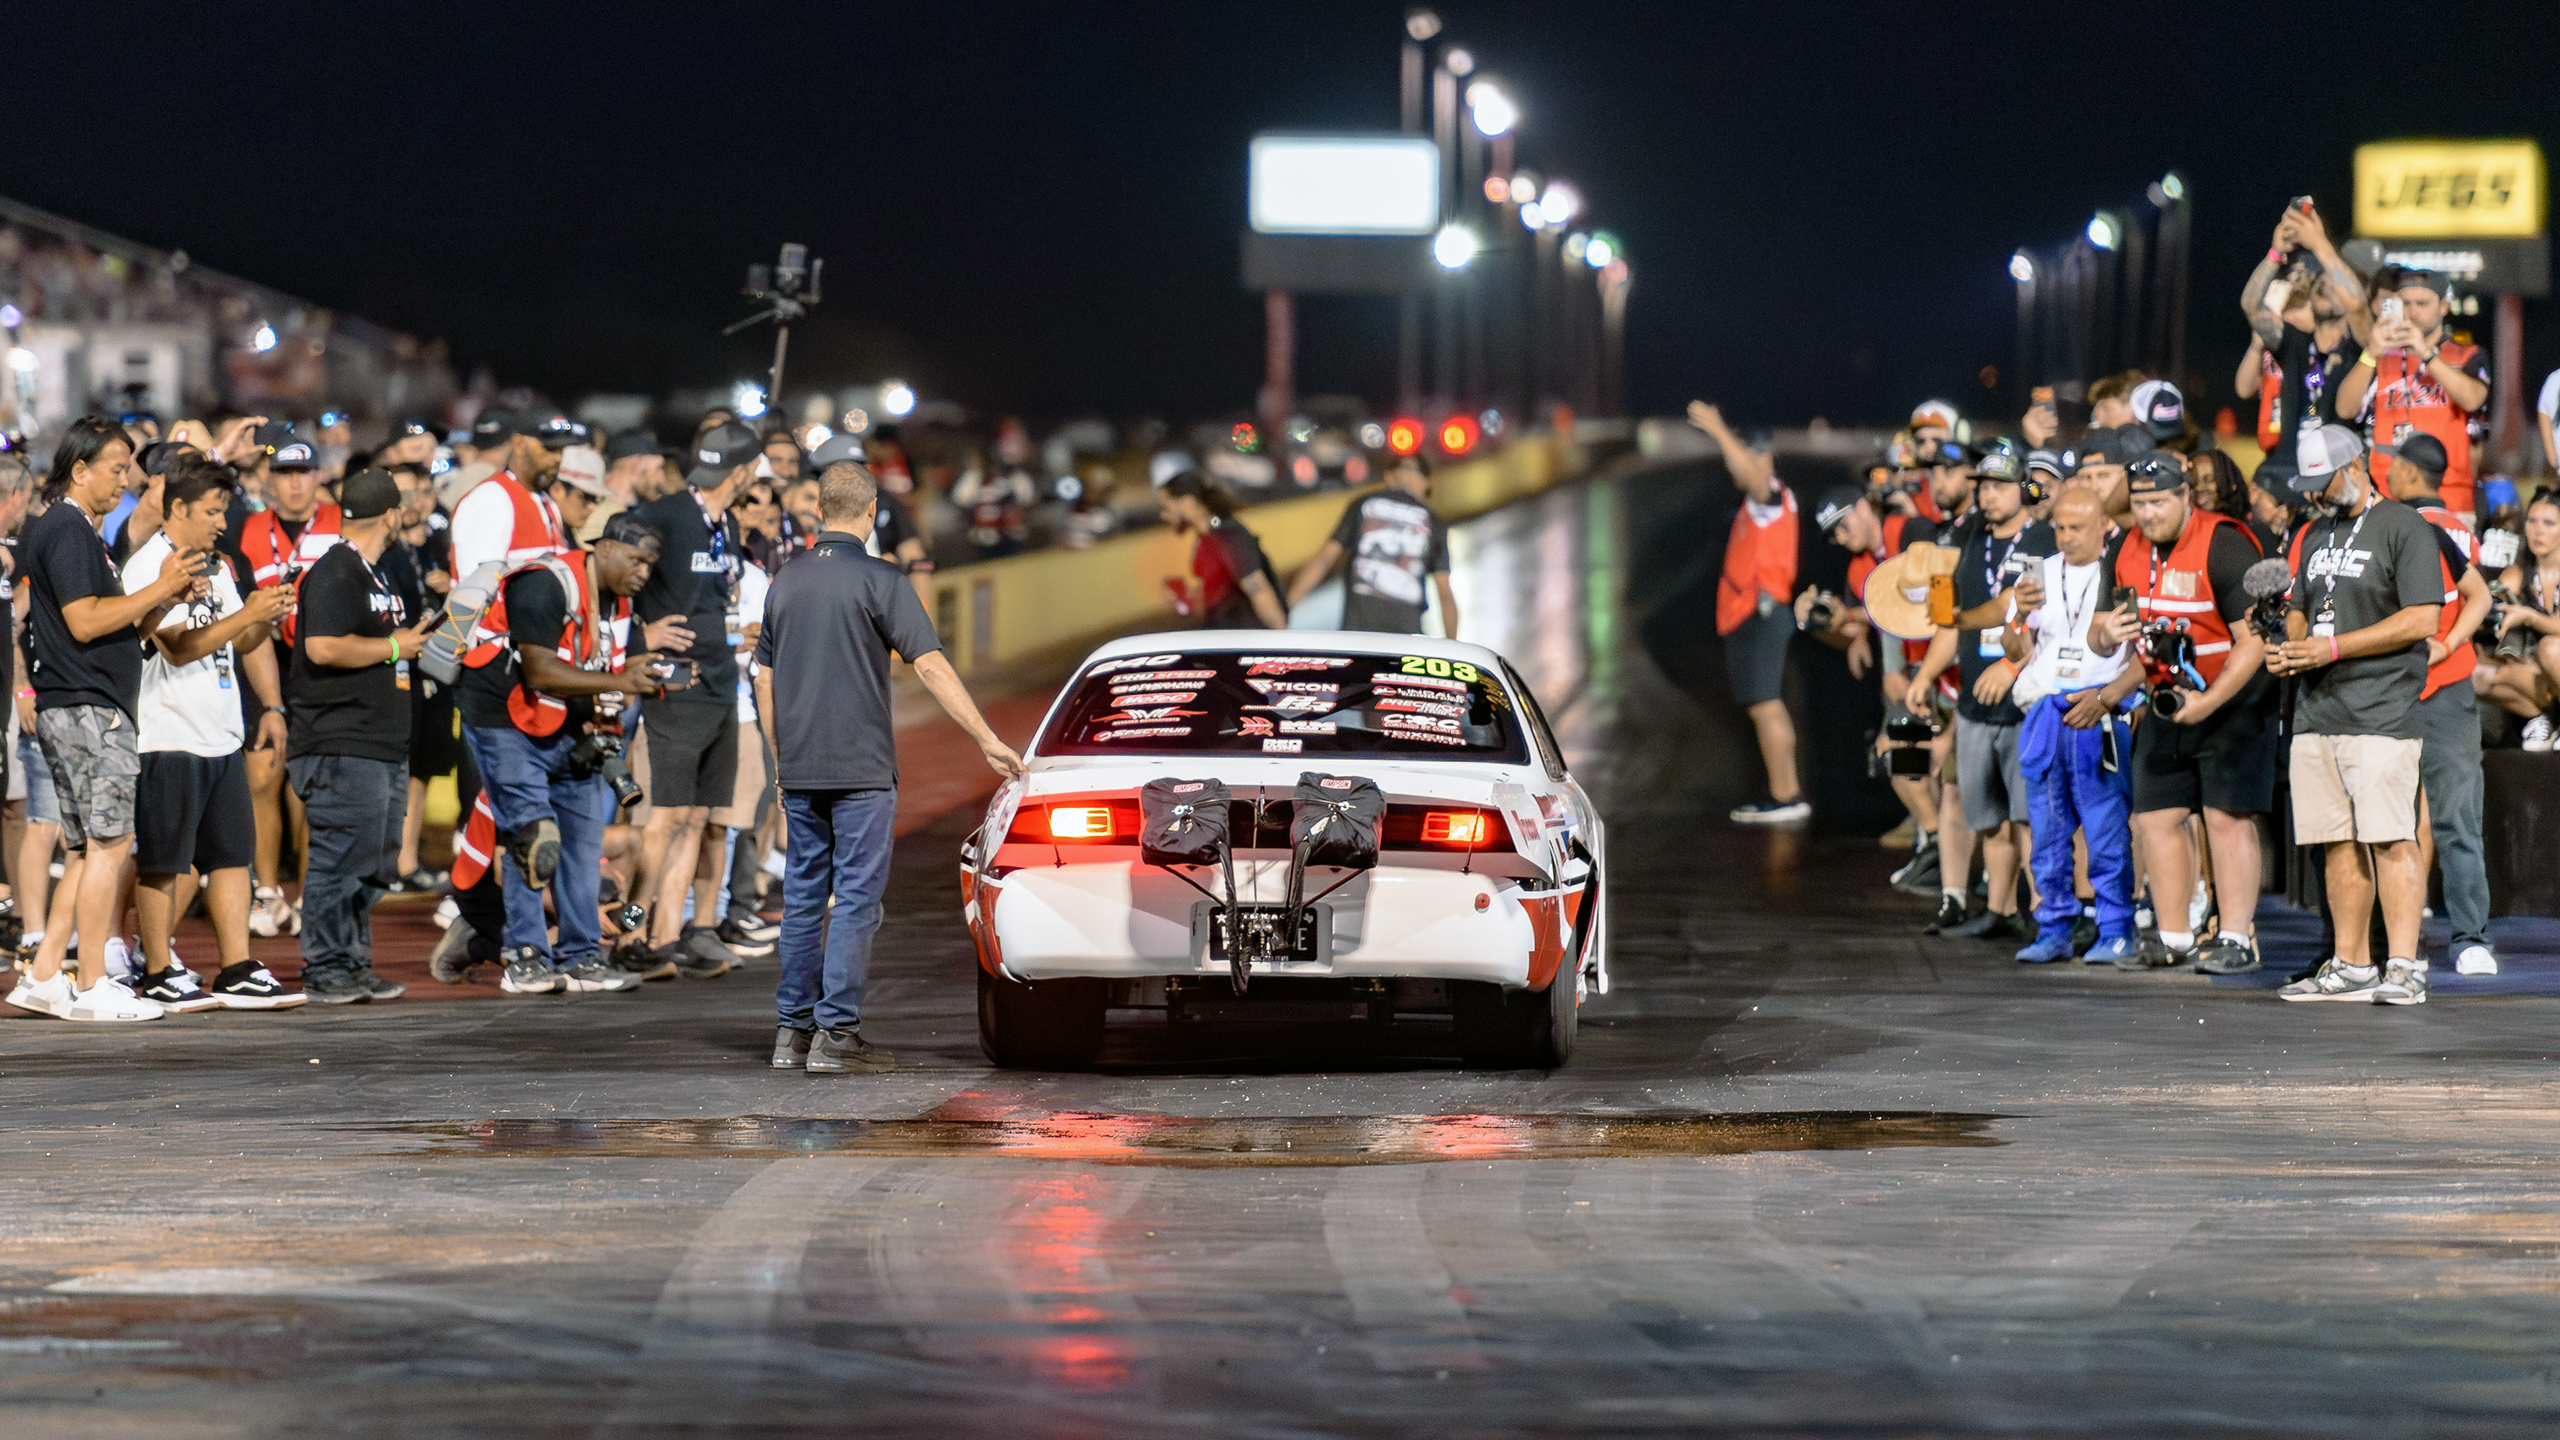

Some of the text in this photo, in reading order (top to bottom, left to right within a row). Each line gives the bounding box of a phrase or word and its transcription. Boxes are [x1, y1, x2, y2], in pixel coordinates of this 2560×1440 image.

[2373, 168, 2516, 211] JEGS
[1401, 656, 1477, 683] 203
[1273, 682, 1338, 693] TICON
[1111, 727, 1191, 738] SPECTRUM
